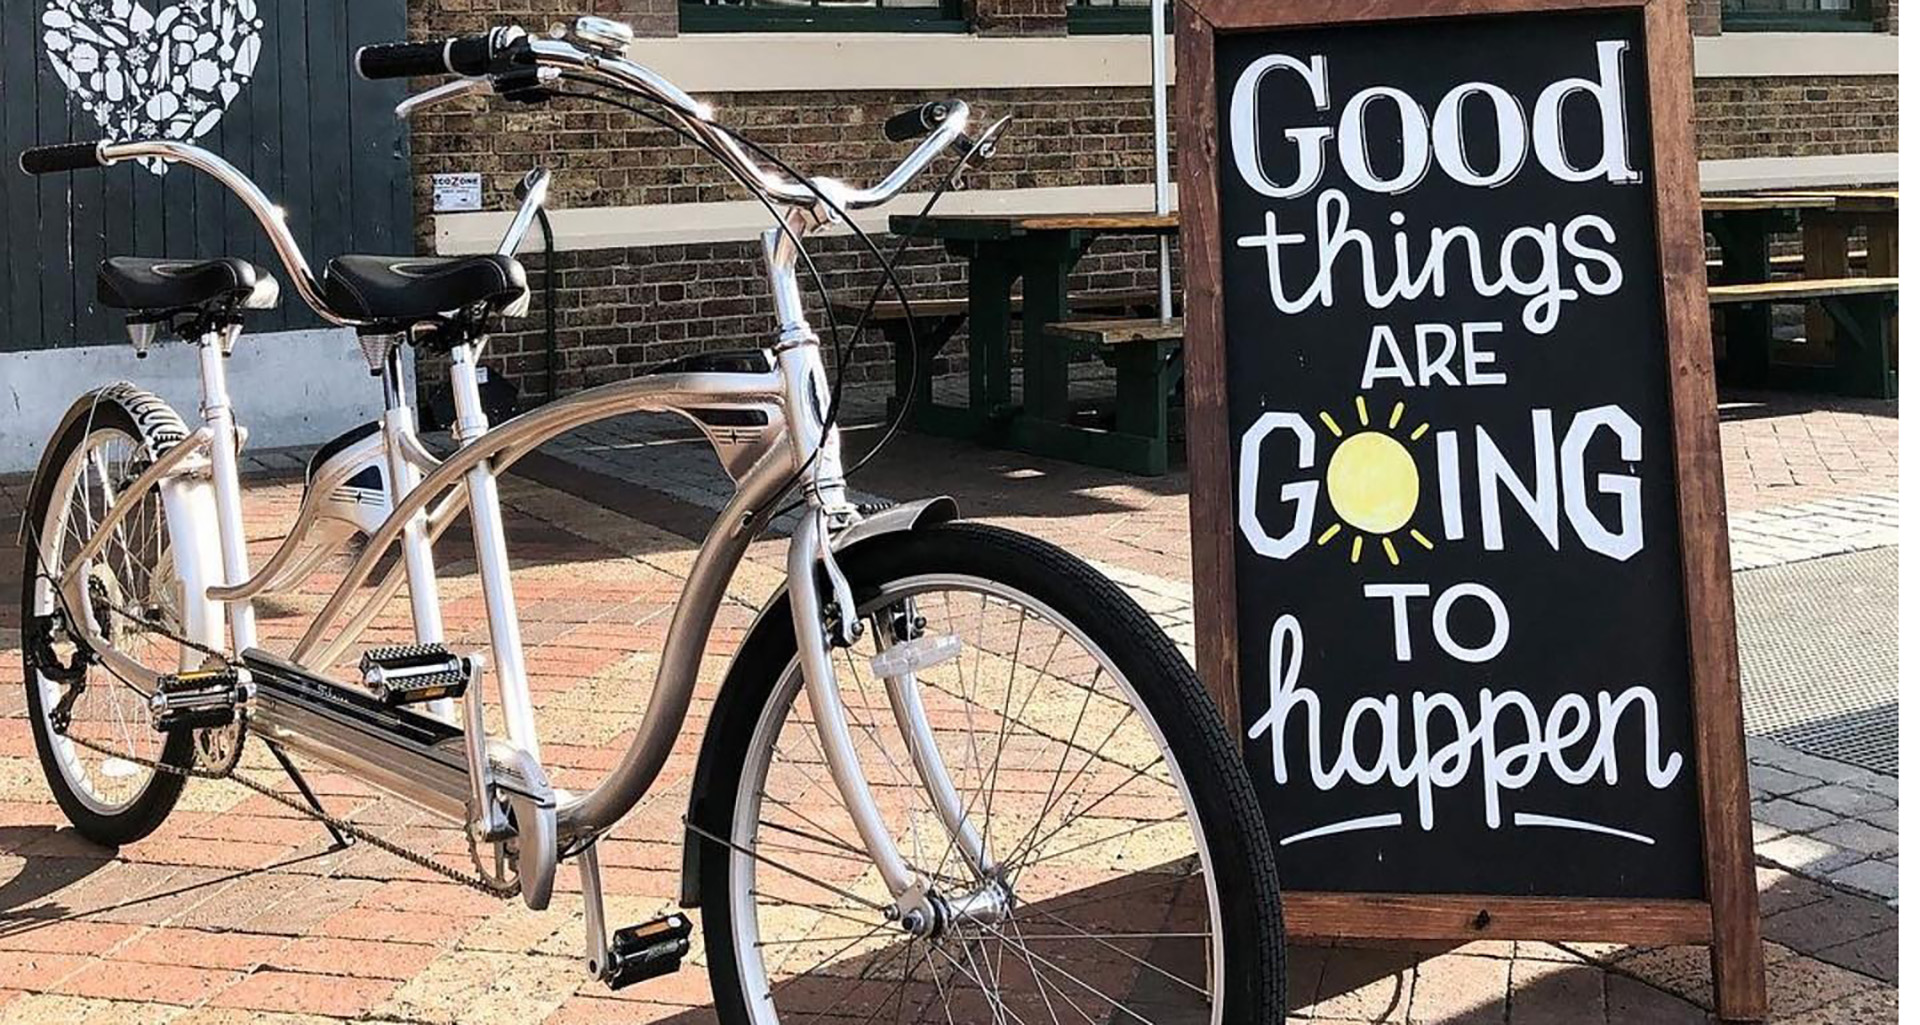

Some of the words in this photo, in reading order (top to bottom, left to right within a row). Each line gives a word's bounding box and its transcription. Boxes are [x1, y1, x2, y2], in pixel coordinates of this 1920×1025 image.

[1230, 40, 1642, 198] Good
[1237, 189, 1623, 334] things
[1361, 322, 1507, 389] ARE
[1364, 583, 1510, 662] TO
[1248, 614, 1683, 830] happen
